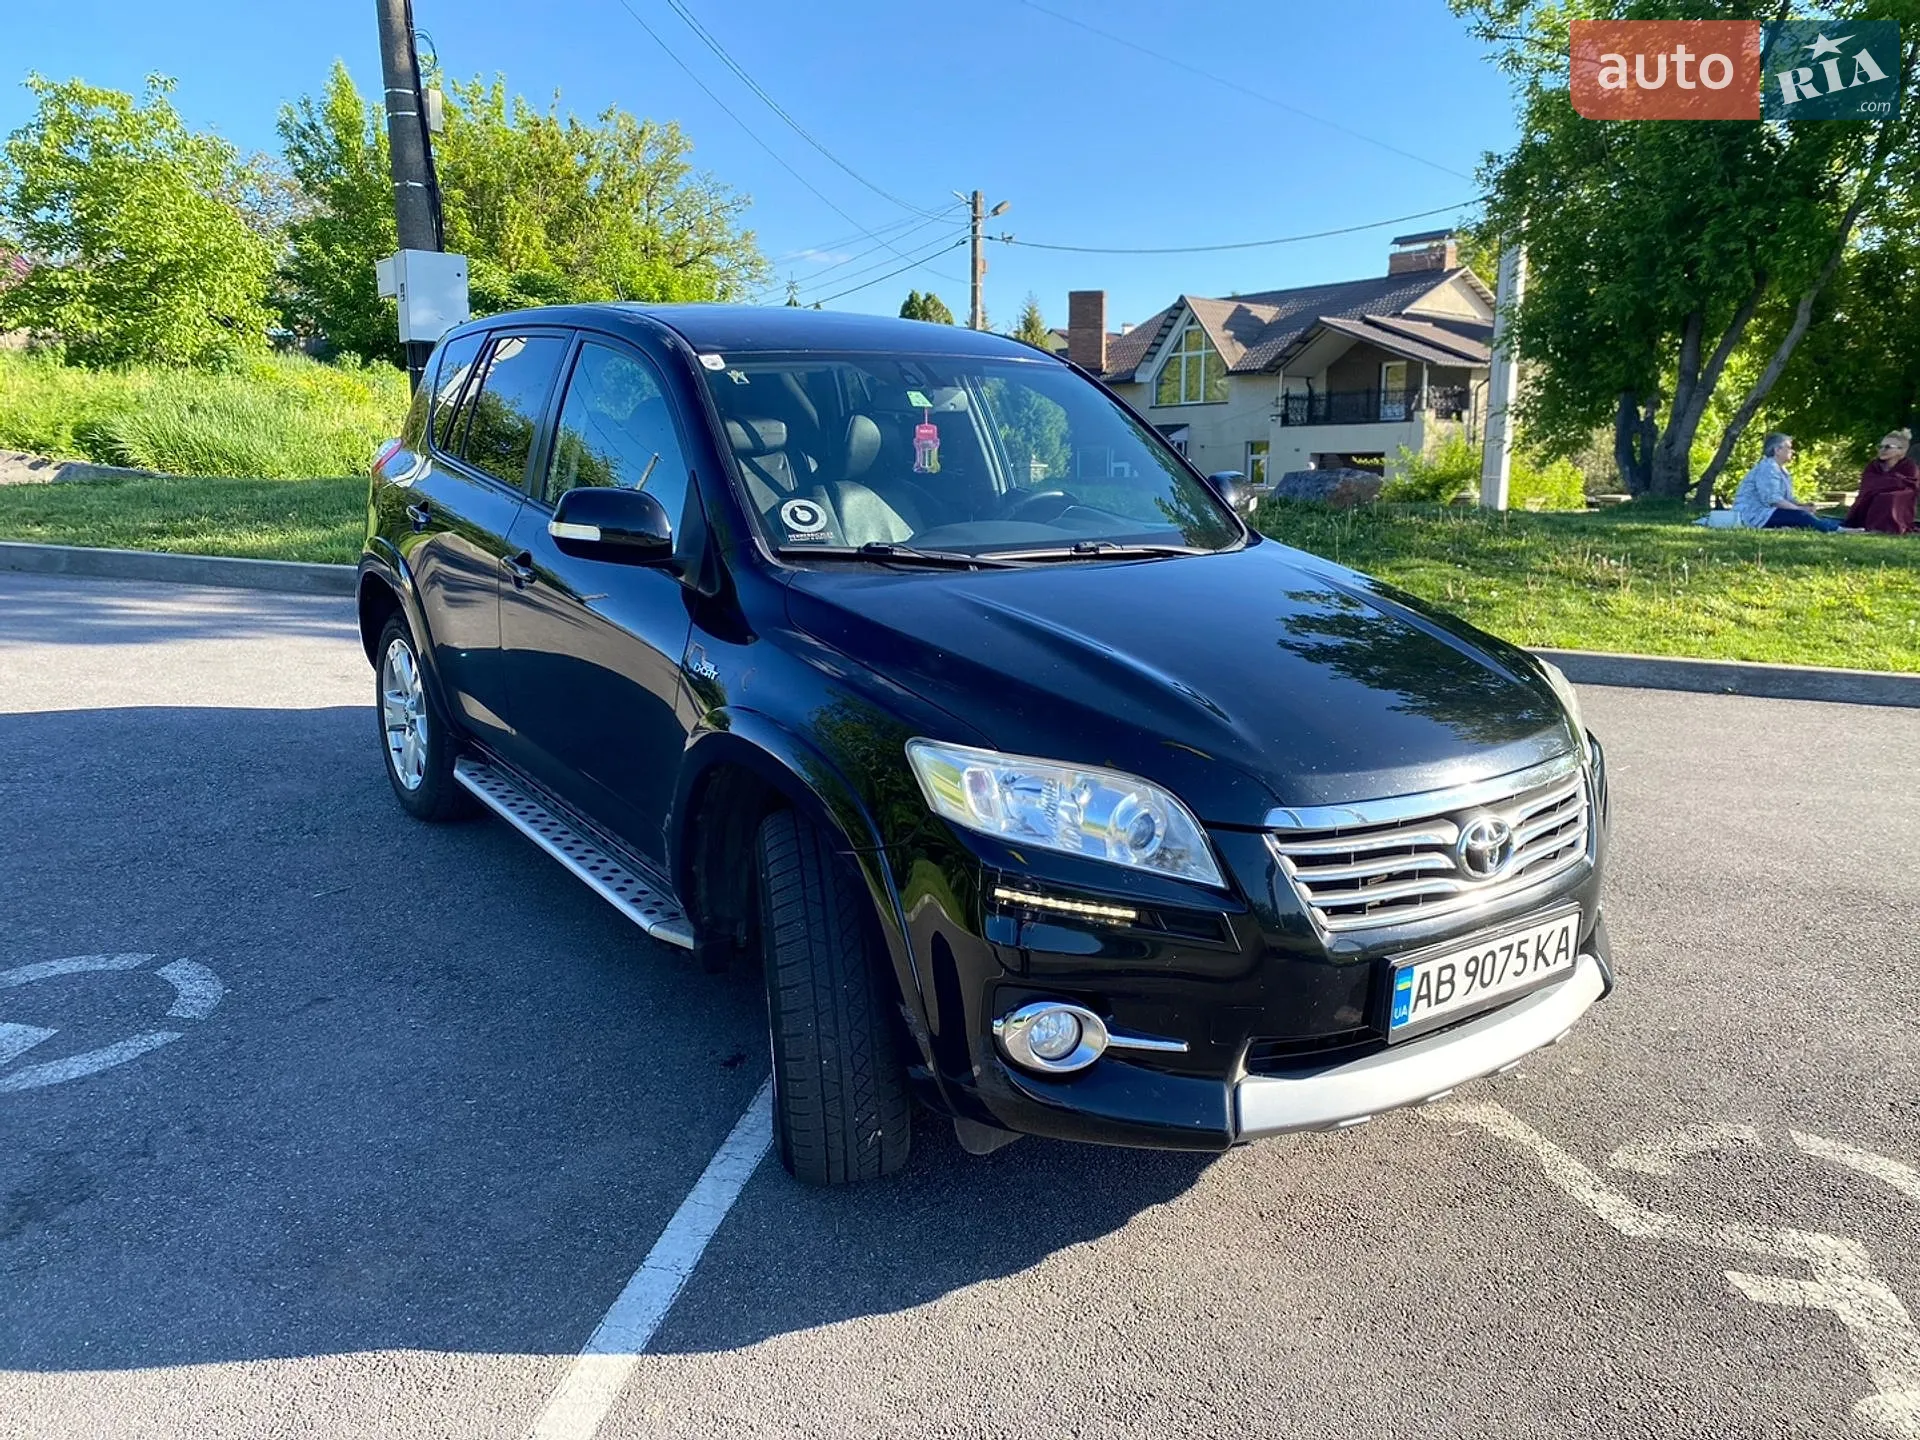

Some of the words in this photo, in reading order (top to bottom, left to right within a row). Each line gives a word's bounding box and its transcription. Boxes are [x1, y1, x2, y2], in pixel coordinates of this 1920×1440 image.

[1411, 963, 1456, 1013] AB
[1463, 938, 1530, 996] 9075
[1533, 925, 1570, 972] KA
[1394, 1005, 1409, 1020] UA
